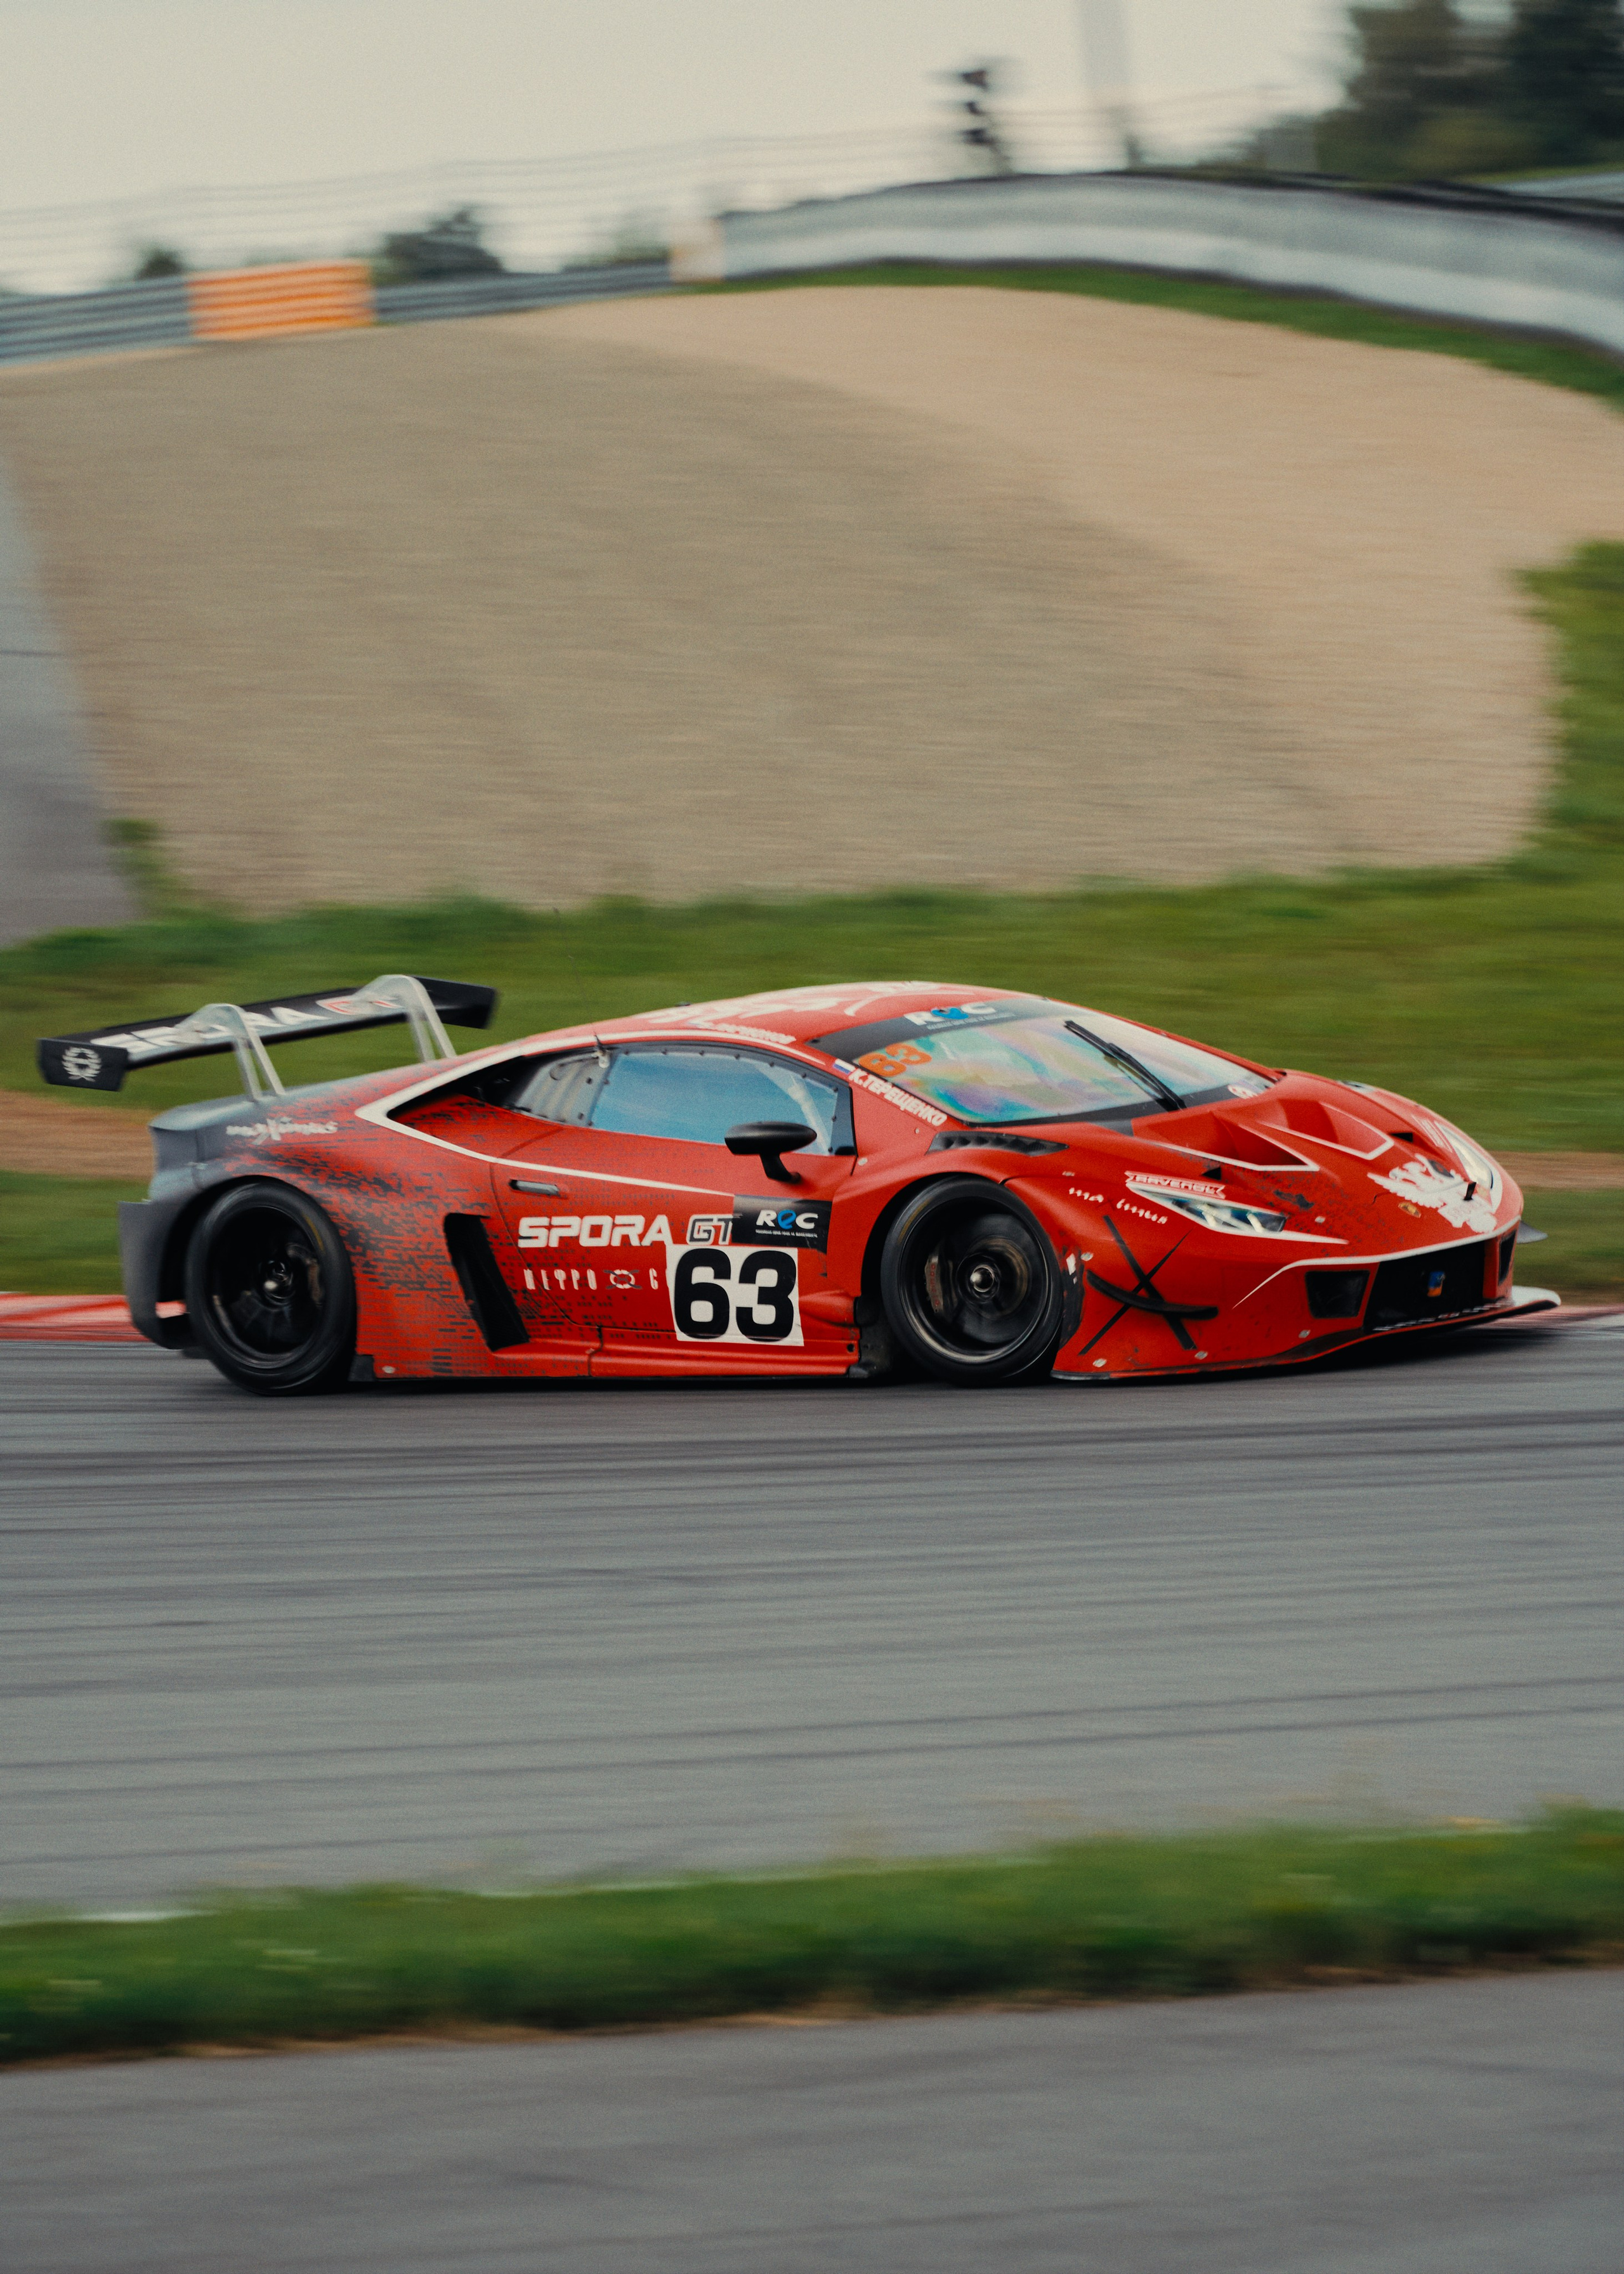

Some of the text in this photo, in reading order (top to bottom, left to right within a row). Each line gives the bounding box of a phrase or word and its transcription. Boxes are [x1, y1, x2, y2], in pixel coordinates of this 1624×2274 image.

[859, 1042, 933, 1077] 63
[518, 1214, 733, 1248] SPORA GT
[674, 1248, 797, 1342] 63
